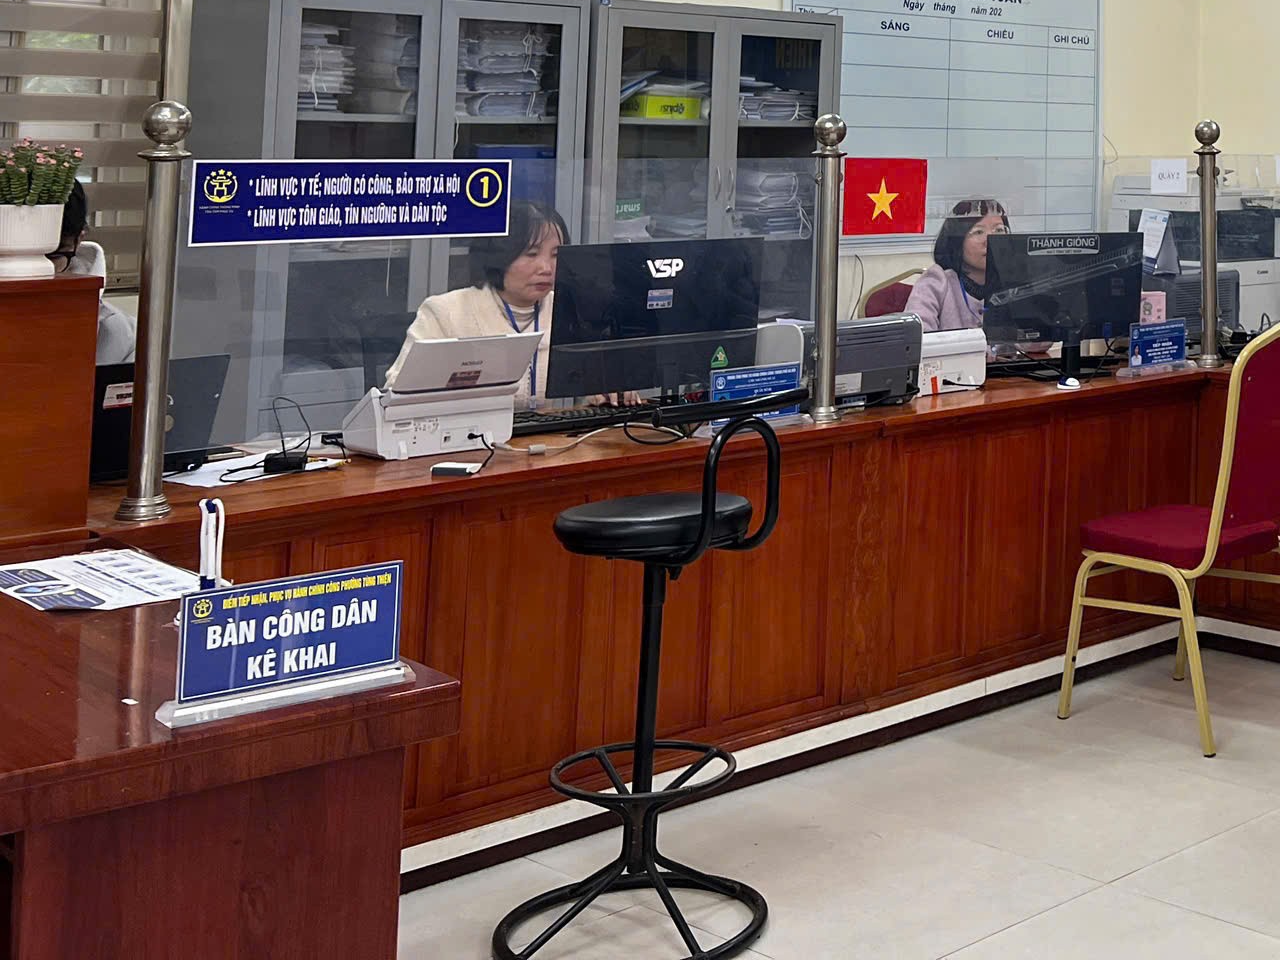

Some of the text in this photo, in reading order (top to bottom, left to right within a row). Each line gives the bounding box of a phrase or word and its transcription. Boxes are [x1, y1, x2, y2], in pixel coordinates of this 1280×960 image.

[902, 0, 1003, 17] Ngày tháng năm 202
[880, 19, 910, 32] SÁNG
[1053, 34, 1090, 45] GHI CHÚ
[255, 171, 461, 200] LĨNH VỰC Y TẾ; NGƯỜI CÓ CÔNG, BẢO TRỢ XÃ HỘI
[480, 176, 489, 199] 1
[253, 205, 276, 228] LĨNH
[278, 206, 297, 230] VỰC
[298, 204, 317, 226] TÔN
[319, 203, 342, 227] GIÁO,
[344, 203, 359, 225] TÍN
[361, 202, 397, 224] NGƯỠNG
[399, 202, 410, 223] VÀ
[411, 202, 430, 223] DÂN
[431, 201, 448, 226] TỘC
[646, 258, 684, 278] VSP
[206, 598, 378, 650] BÀN CÔNG DÂN
[246, 642, 337, 681] KÊ KHAI
